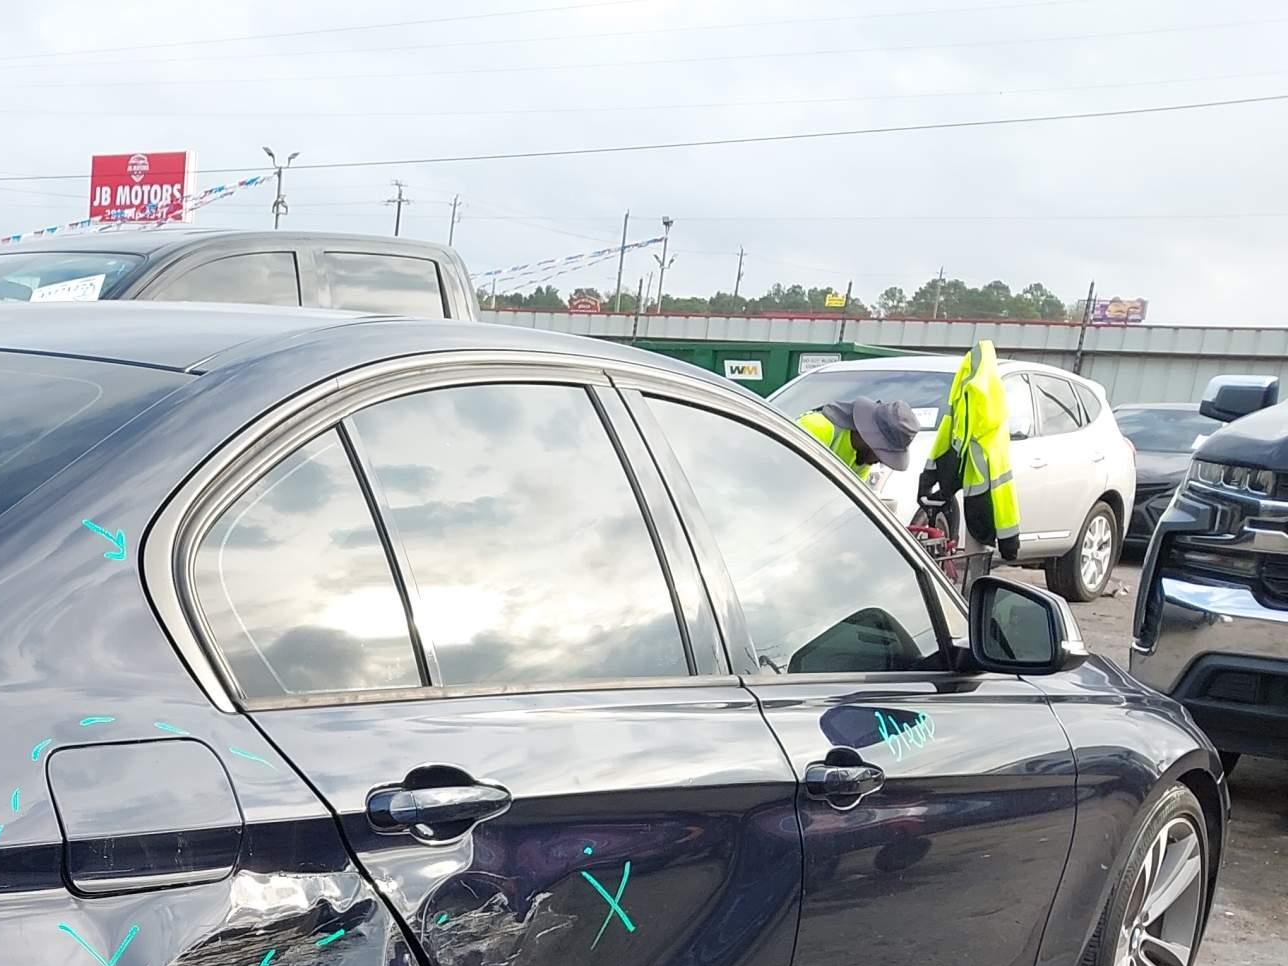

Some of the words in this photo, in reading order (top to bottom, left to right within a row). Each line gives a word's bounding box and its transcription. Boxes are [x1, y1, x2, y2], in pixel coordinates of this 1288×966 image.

[92, 185, 112, 208] JB
[115, 183, 182, 206] MOTORS
[729, 365, 758, 376] WM
